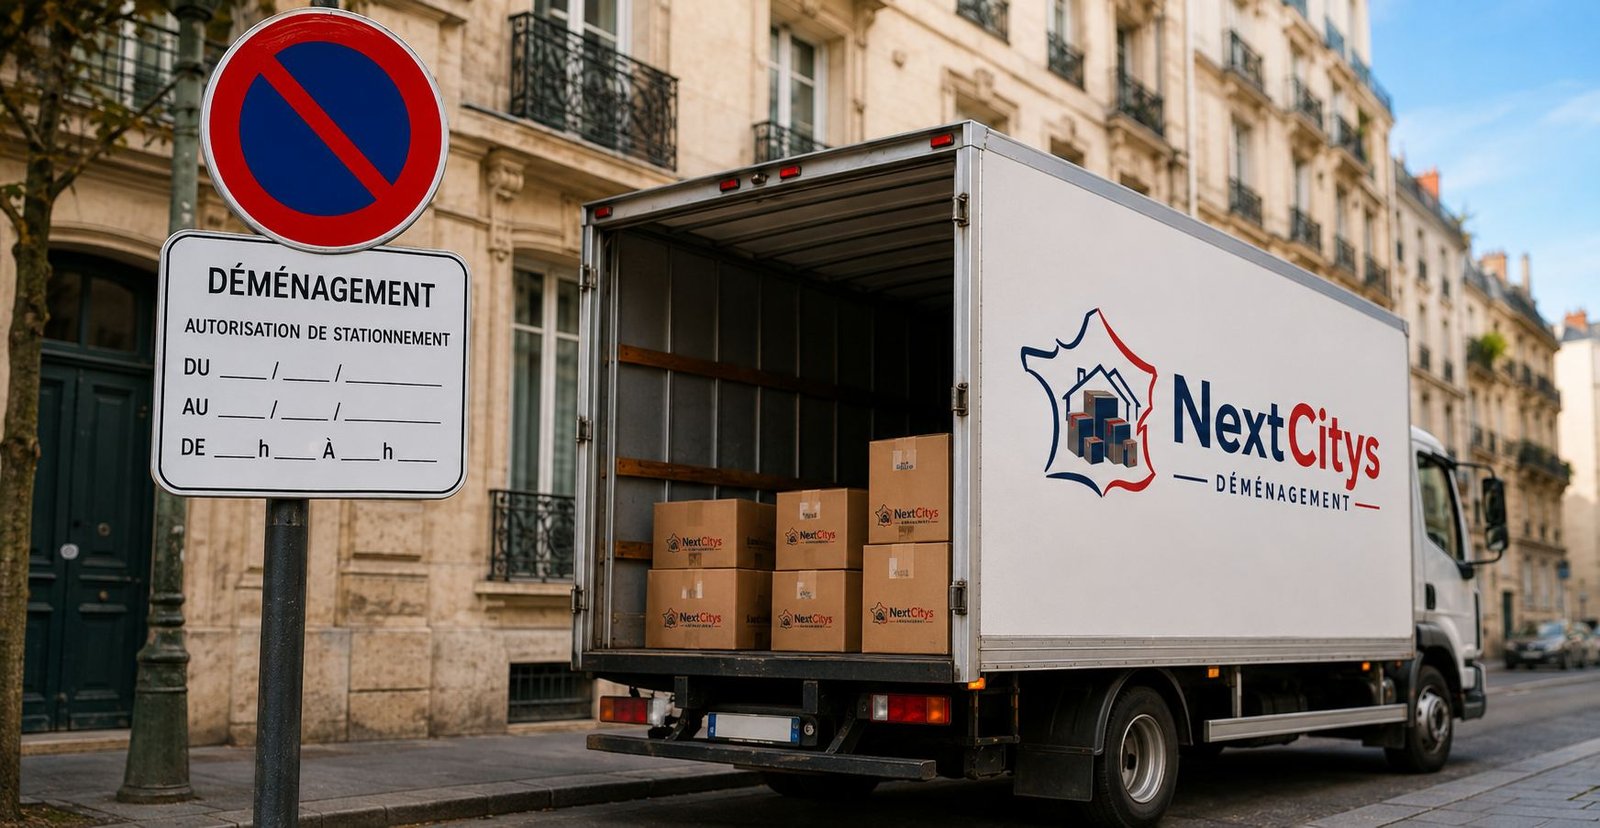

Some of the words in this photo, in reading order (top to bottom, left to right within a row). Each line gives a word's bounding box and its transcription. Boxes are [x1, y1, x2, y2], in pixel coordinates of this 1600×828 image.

[209, 263, 435, 307] DÉMÉNAGEMENT
[185, 318, 300, 339] AUTORISATION
[308, 325, 327, 340] DE
[334, 327, 450, 346] STATIONNEMENT
[185, 358, 209, 376] DU
[182, 398, 208, 415] AU
[1174, 374, 1380, 490] NextCitys
[182, 438, 205, 455] DE
[259, 439, 269, 457] h
[323, 438, 335, 459] À
[384, 442, 392, 459] h
[1217, 472, 1350, 511] DÉMÉNAGEMENT
[894, 507, 939, 521] NextCitys
[682, 536, 722, 547] NextCitys
[800, 530, 836, 542] NextCitys
[680, 612, 722, 623] NextCitys
[794, 613, 833, 625] NextCitys
[889, 607, 934, 620] NextCitys
